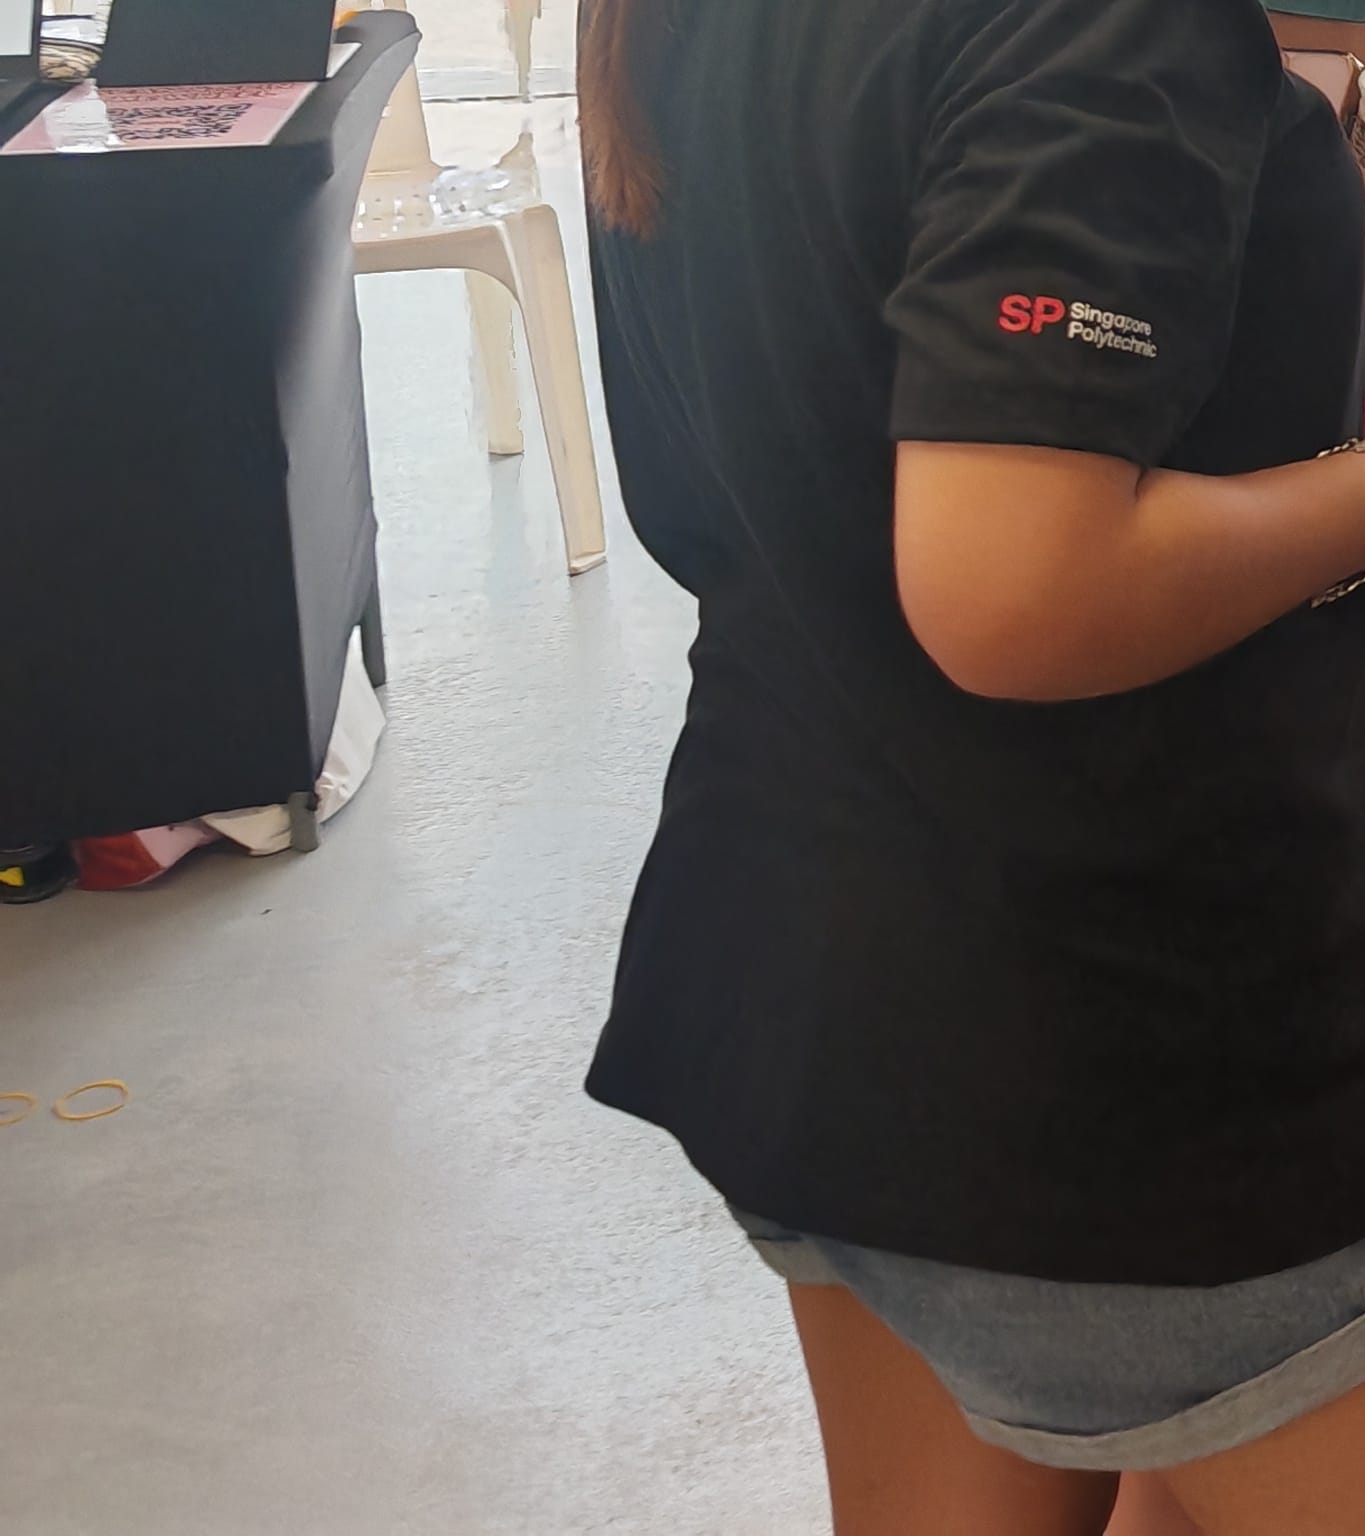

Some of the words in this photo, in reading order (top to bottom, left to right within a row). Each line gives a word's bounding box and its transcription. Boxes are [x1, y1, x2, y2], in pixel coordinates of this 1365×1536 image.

[998, 293, 1065, 334] SP
[1070, 301, 1152, 337] Singapore
[1067, 321, 1157, 358] Polytechnic
